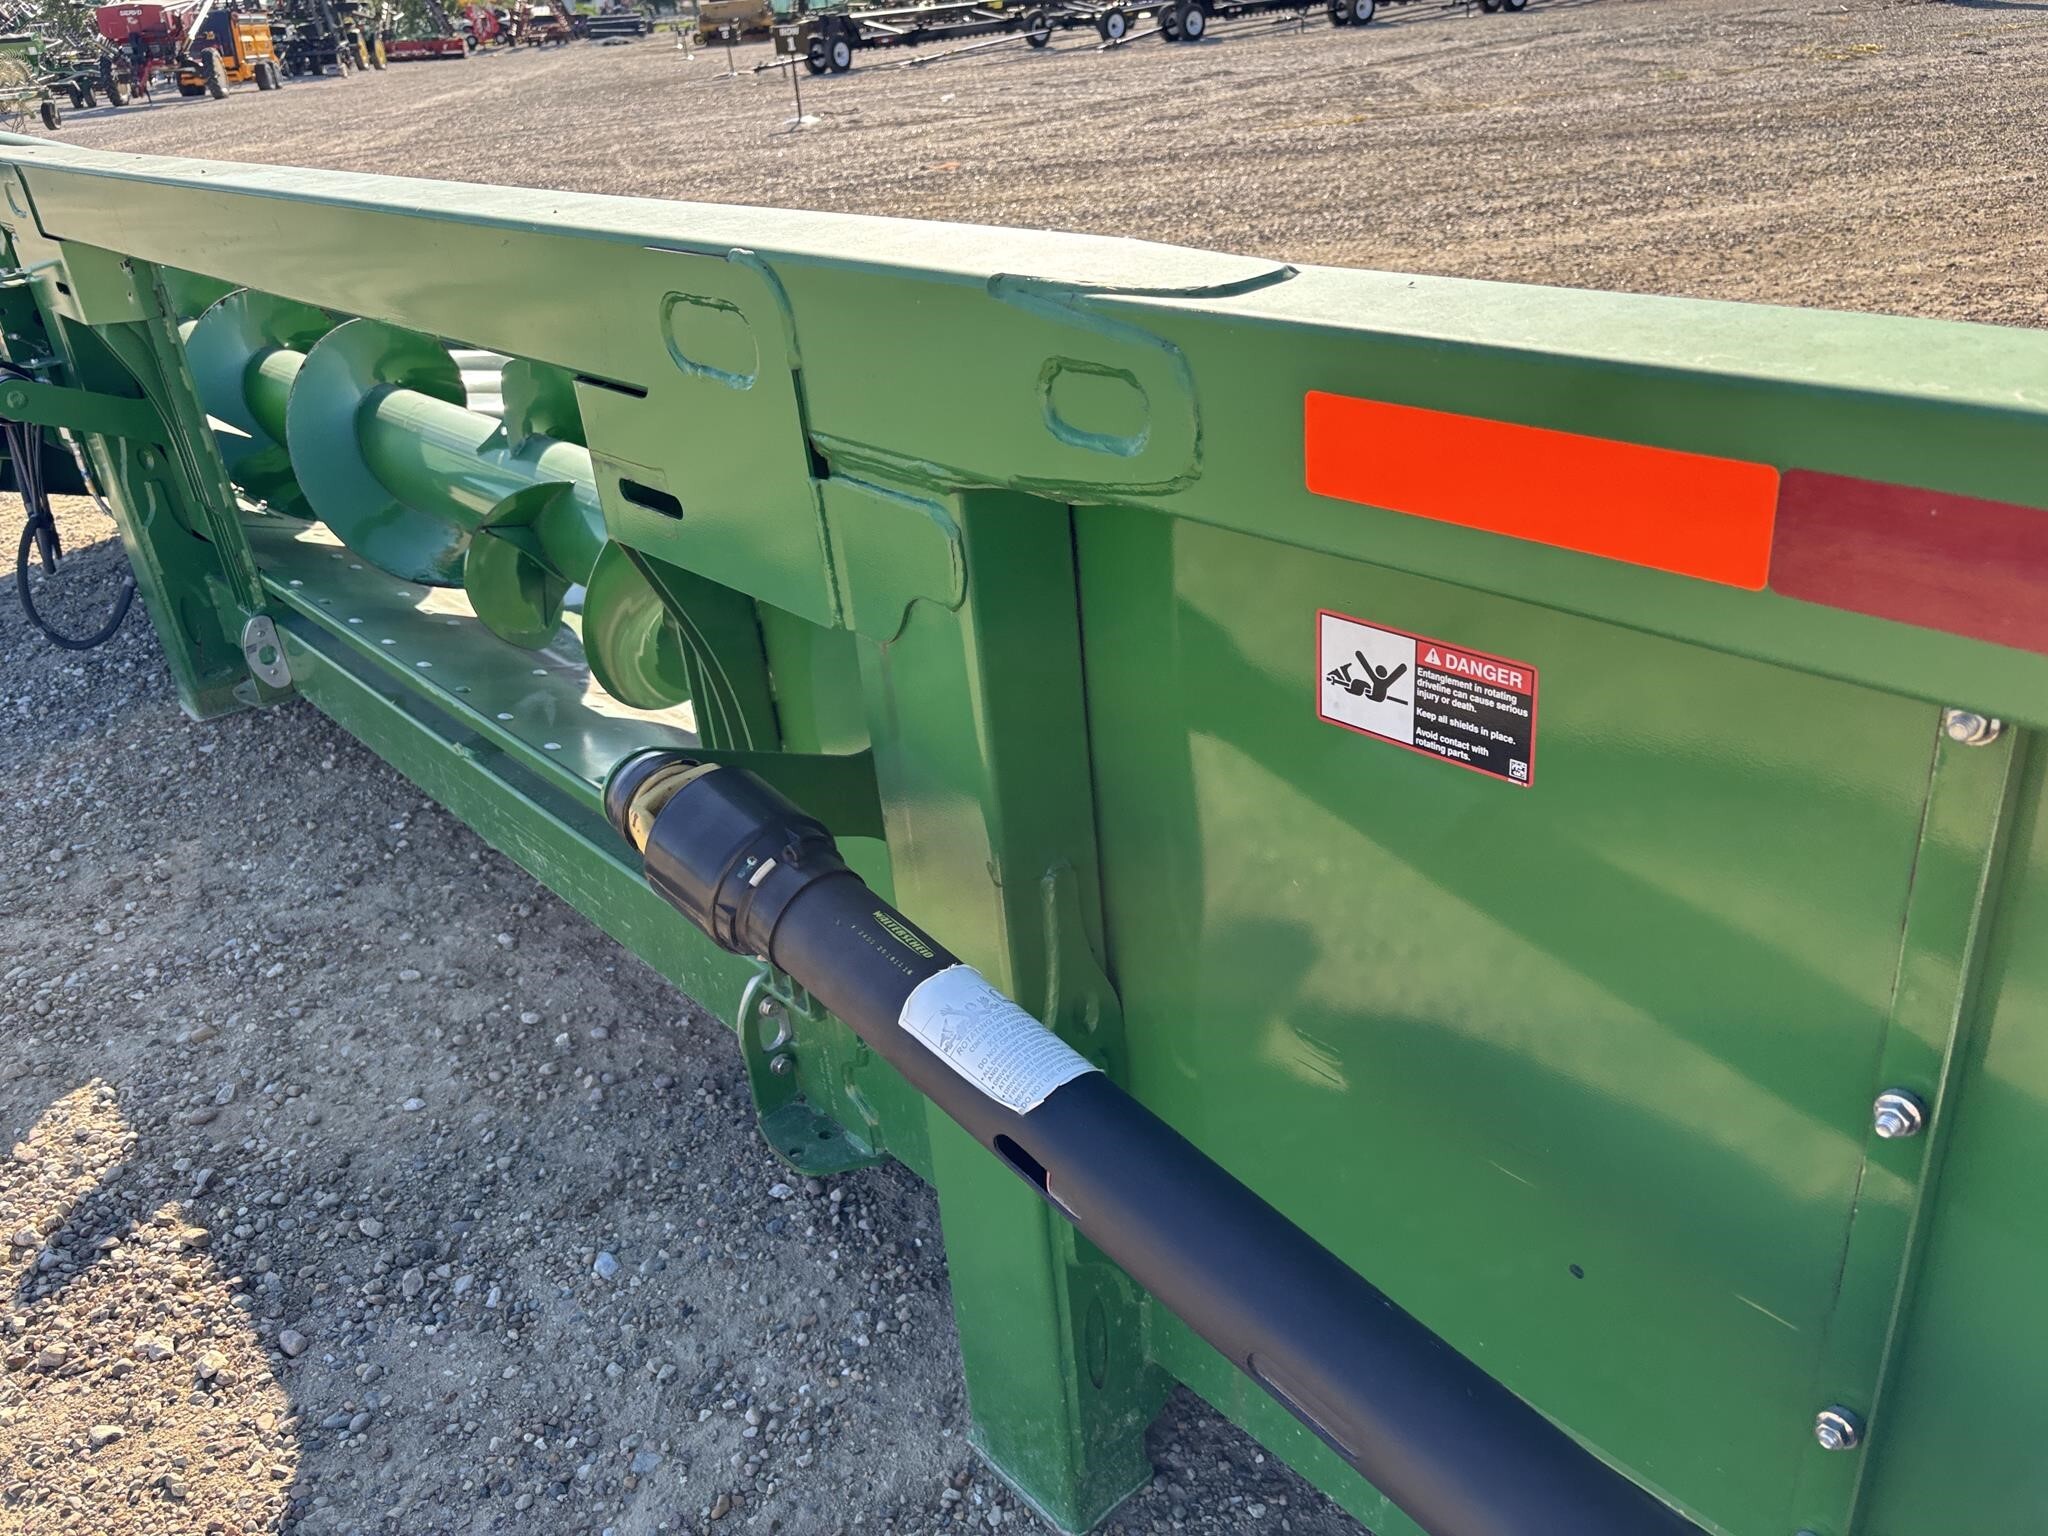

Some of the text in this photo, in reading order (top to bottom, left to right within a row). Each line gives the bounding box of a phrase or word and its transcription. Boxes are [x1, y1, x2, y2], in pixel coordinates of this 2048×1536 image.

[787, 37, 797, 52] 1
[1417, 667, 1518, 705] Entanglement in rotating
[1445, 653, 1522, 688] DANGER
[1416, 688, 1477, 713] injury or death.
[1417, 678, 1529, 718] driveline can cause serious
[1415, 726, 1489, 757] Avoid contact with
[1416, 707, 1516, 745] Keep all shields in place.
[1415, 737, 1471, 761] rotating parts.
[872, 910, 934, 958] WALTERSCHEID
[955, 1018, 992, 1055] ROTATING
[977, 1056, 989, 1070] DO
[986, 1043, 1000, 1058] NOT
[981, 1063, 993, 1077] ALL
[986, 1065, 999, 1081] AND
[997, 1058, 1025, 1089] ATTACHED
[1020, 1095, 1032, 1108] DO
[1028, 1081, 1044, 1096] NOT
